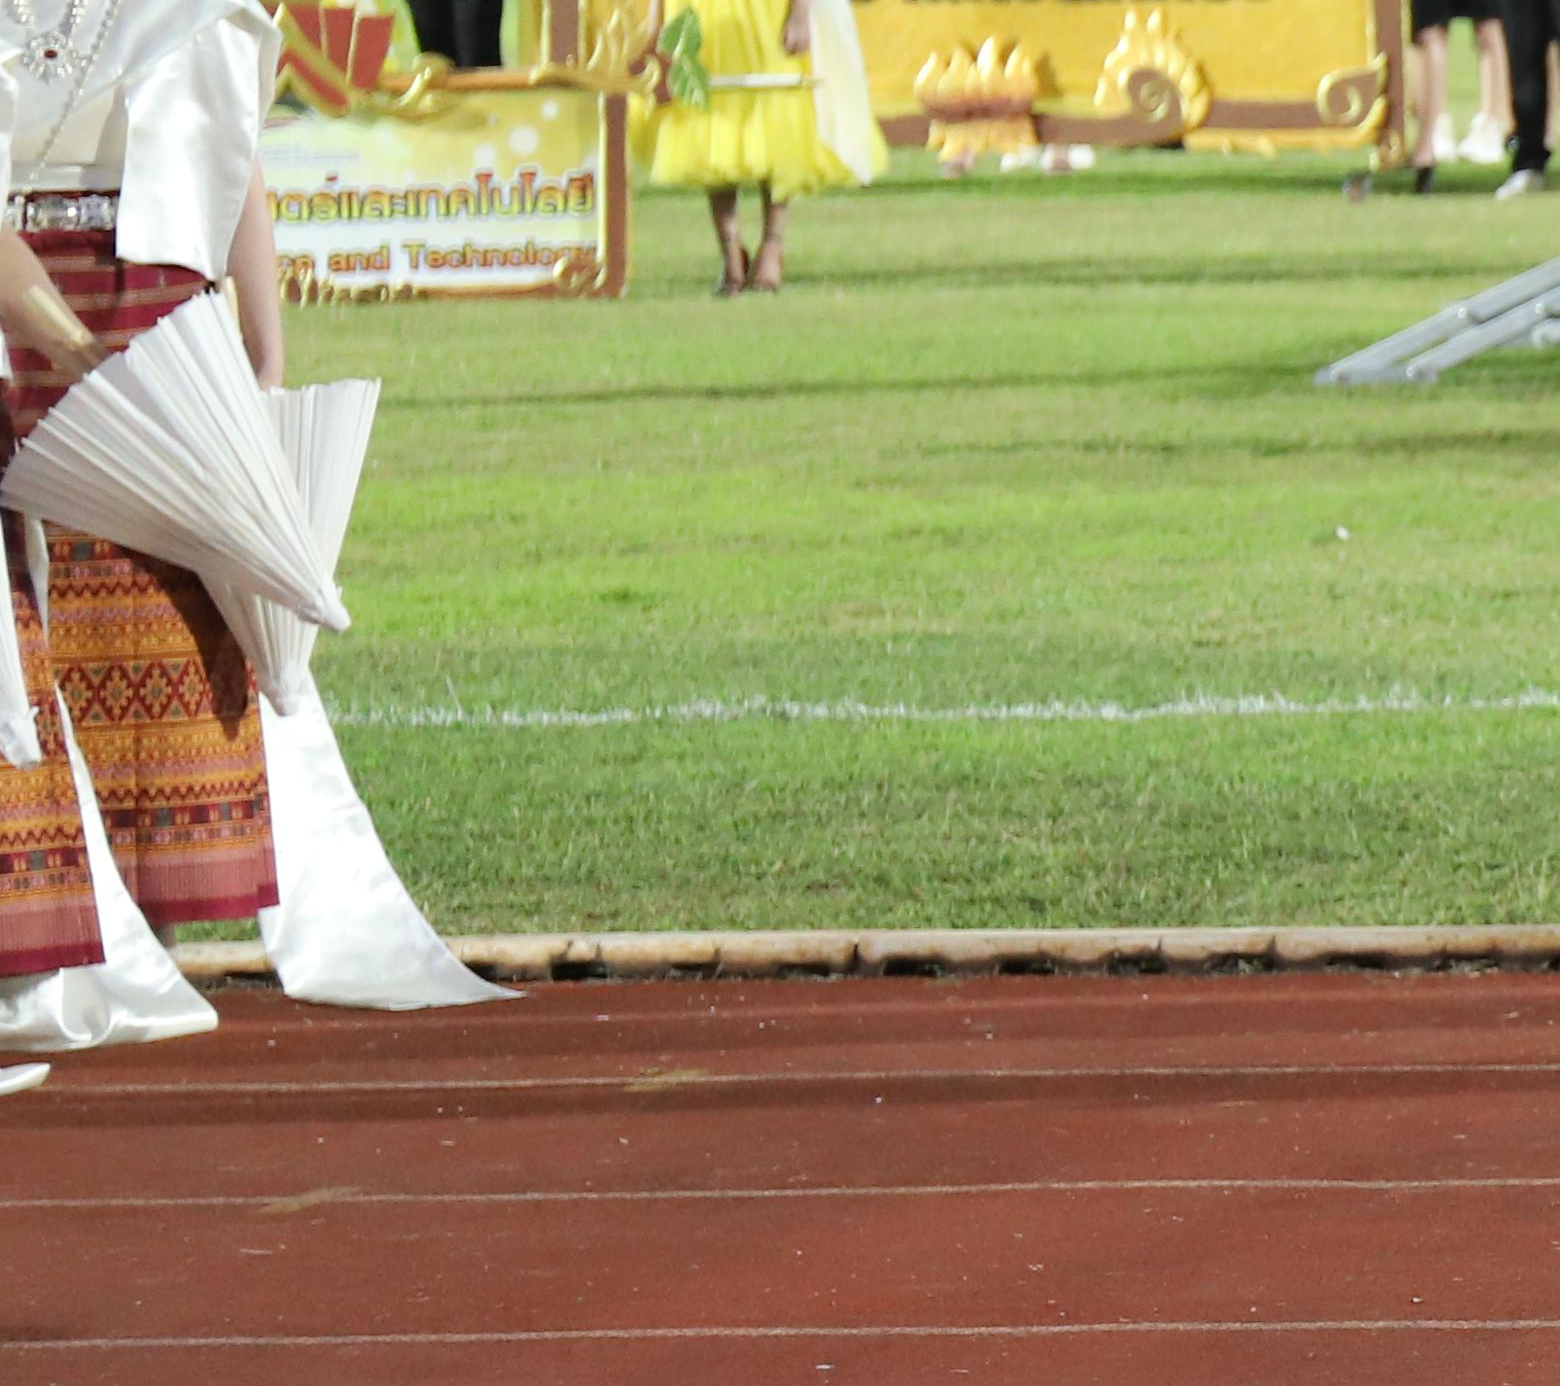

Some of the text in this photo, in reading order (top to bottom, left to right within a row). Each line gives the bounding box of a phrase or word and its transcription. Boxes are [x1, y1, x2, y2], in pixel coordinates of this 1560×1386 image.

[266, 171, 596, 221] ตร์และเทคโนโลยี
